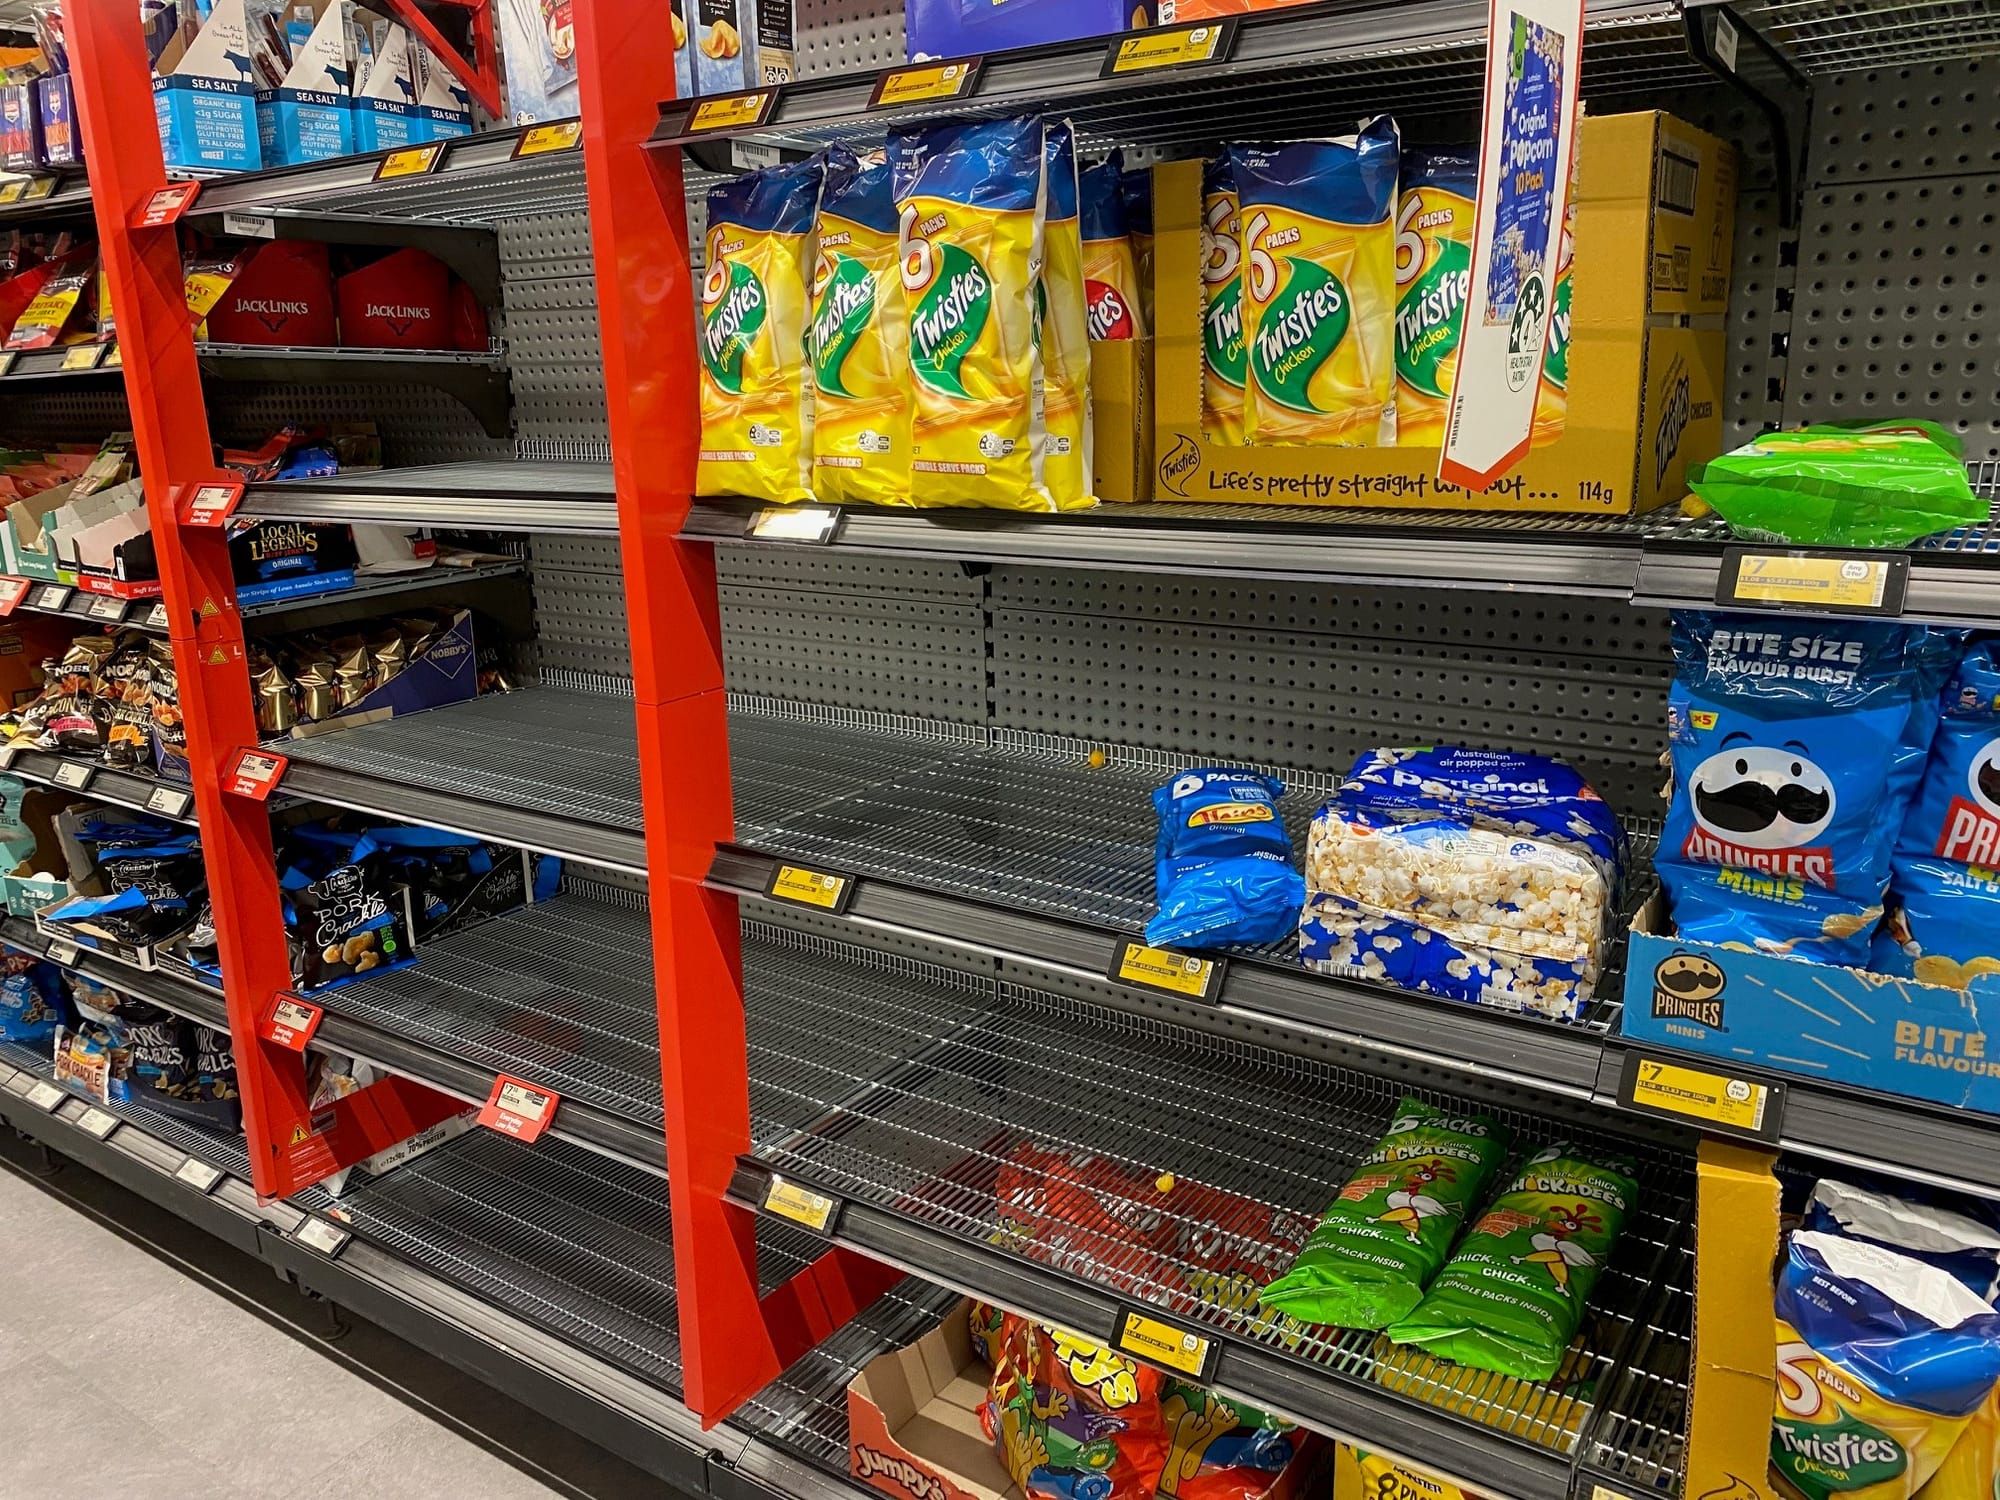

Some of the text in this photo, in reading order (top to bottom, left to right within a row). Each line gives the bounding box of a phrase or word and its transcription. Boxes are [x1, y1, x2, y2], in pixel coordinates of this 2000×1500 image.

[1123, 40, 1141, 53] $7
[191, 78, 239, 93] SEA SALT
[296, 91, 337, 105] SEA SALT
[193, 98, 225, 109] ORGANIC
[212, 110, 243, 121] SUGAR
[373, 100, 405, 114] SEA SALT
[431, 109, 461, 122] SEA SALT
[314, 121, 340, 132] SUGAR
[1518, 107, 1548, 138] Original
[1509, 138, 1554, 170] Popcorn
[1515, 166, 1544, 196] 10 Pack
[819, 231, 852, 249] PACKS
[900, 202, 948, 291] 6 PACKS
[1396, 194, 1453, 285] 6 PACKS
[703, 227, 728, 305] 6
[1246, 212, 1300, 304] 6 PACKS
[235, 298, 309, 315] JACK LINK'S
[365, 303, 431, 320] JACK LINK'S
[813, 271, 874, 358] Twisties
[912, 264, 987, 360] Twisties
[1396, 269, 1470, 355] Twistie
[705, 279, 762, 362] Twisties
[1256, 279, 1343, 374] Twisties
[932, 329, 968, 371] Chicken
[1410, 326, 1452, 367] Chicken
[1273, 345, 1316, 385] Chicken
[1512, 370, 1526, 383] RATING
[1690, 401, 1713, 421] CHICKEN
[938, 461, 960, 474] SERVE
[960, 462, 986, 475] PACKS
[1163, 449, 1199, 484] Twisties
[1209, 469, 1429, 498] Life's pretty straight
[1577, 480, 1614, 504] 114g
[259, 522, 305, 540] LOCAL
[248, 532, 319, 561] LEGENDS
[271, 557, 303, 569] ORIGINAL
[1744, 558, 1767, 574] $7
[269, 586, 278, 595] of
[431, 643, 469, 660] NOBBY'S
[1711, 629, 1864, 664] BITE SIZE
[1707, 656, 1858, 684] FLAVOUR BURST
[1692, 712, 1713, 727] x5
[1439, 759, 1455, 767] air
[1455, 758, 1499, 769] popped
[1452, 749, 1511, 761] Australian
[1208, 823, 1247, 835] Original
[1687, 827, 1828, 889] PRINGLES
[1716, 867, 1805, 901] MINIS
[1942, 871, 2000, 894] SALT &
[312, 890, 385, 923] PORK
[315, 901, 388, 947] Crackle
[1128, 946, 1143, 960] $7
[1655, 992, 1721, 1026] PRINGLES
[1665, 1024, 1706, 1040] MINIS
[1894, 1020, 1988, 1058] BITE
[56, 1052, 102, 1087] PORK CRACKLE
[1642, 1063, 1664, 1081] $7
[1894, 1046, 2000, 1078] FLAVOUR
[1422, 1117, 1488, 1137] PACKS
[407, 1130, 446, 1154] 70% PROTEIN
[1336, 1247, 1370, 1262] PACKS
[1371, 1253, 1406, 1271] INSIDE
[1443, 1279, 1480, 1298] SINGLE
[1480, 1288, 1518, 1306] PACKS
[1518, 1296, 1555, 1324] INSIDE
[1811, 1275, 1858, 1307] BEST BEFORE
[1129, 1315, 1144, 1330] $7
[1816, 1366, 1862, 1404] PACKS
[1772, 1423, 1900, 1470] Twisties
[1392, 1463, 1443, 1495] MONSTER
[1793, 1455, 1850, 1482] Chicken
